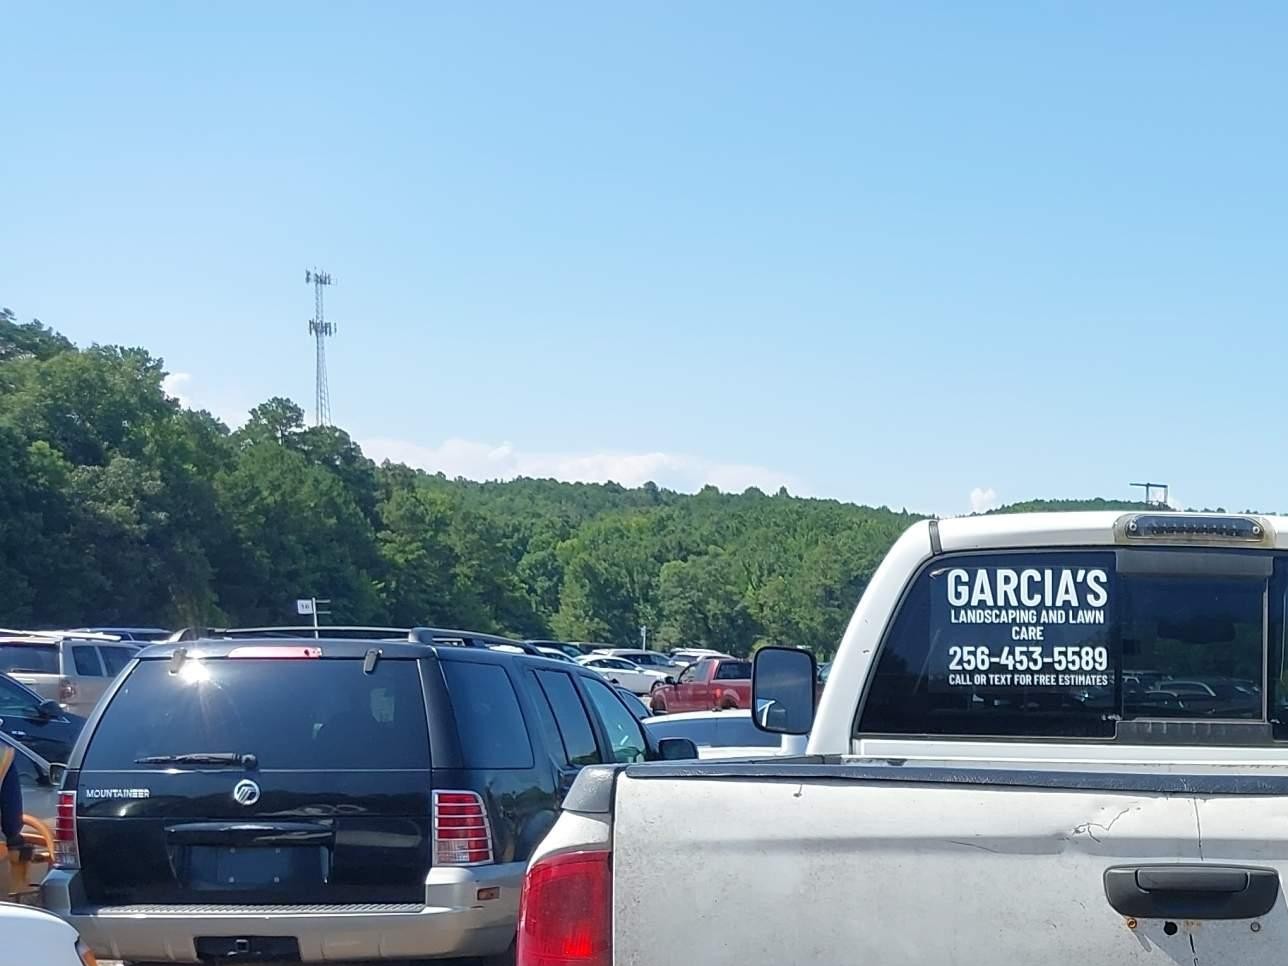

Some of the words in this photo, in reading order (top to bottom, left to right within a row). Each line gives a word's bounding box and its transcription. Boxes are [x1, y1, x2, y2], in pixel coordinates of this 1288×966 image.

[947, 568, 1108, 607] GARCIA'S
[951, 609, 1037, 624] LANDSCAPING
[1040, 609, 1066, 624] AND
[1069, 609, 1104, 624] LAWN
[1011, 626, 1044, 640] CARE
[948, 646, 1108, 671] 256-453-5589
[949, 673, 973, 686] CALL
[974, 673, 986, 686] OR
[988, 673, 1013, 686] TEXT
[1014, 673, 1032, 686] FOR
[1034, 673, 1057, 686] FREE
[1058, 673, 1108, 686] ESTIMATES
[86, 788, 151, 799] MOUNTAINEER
